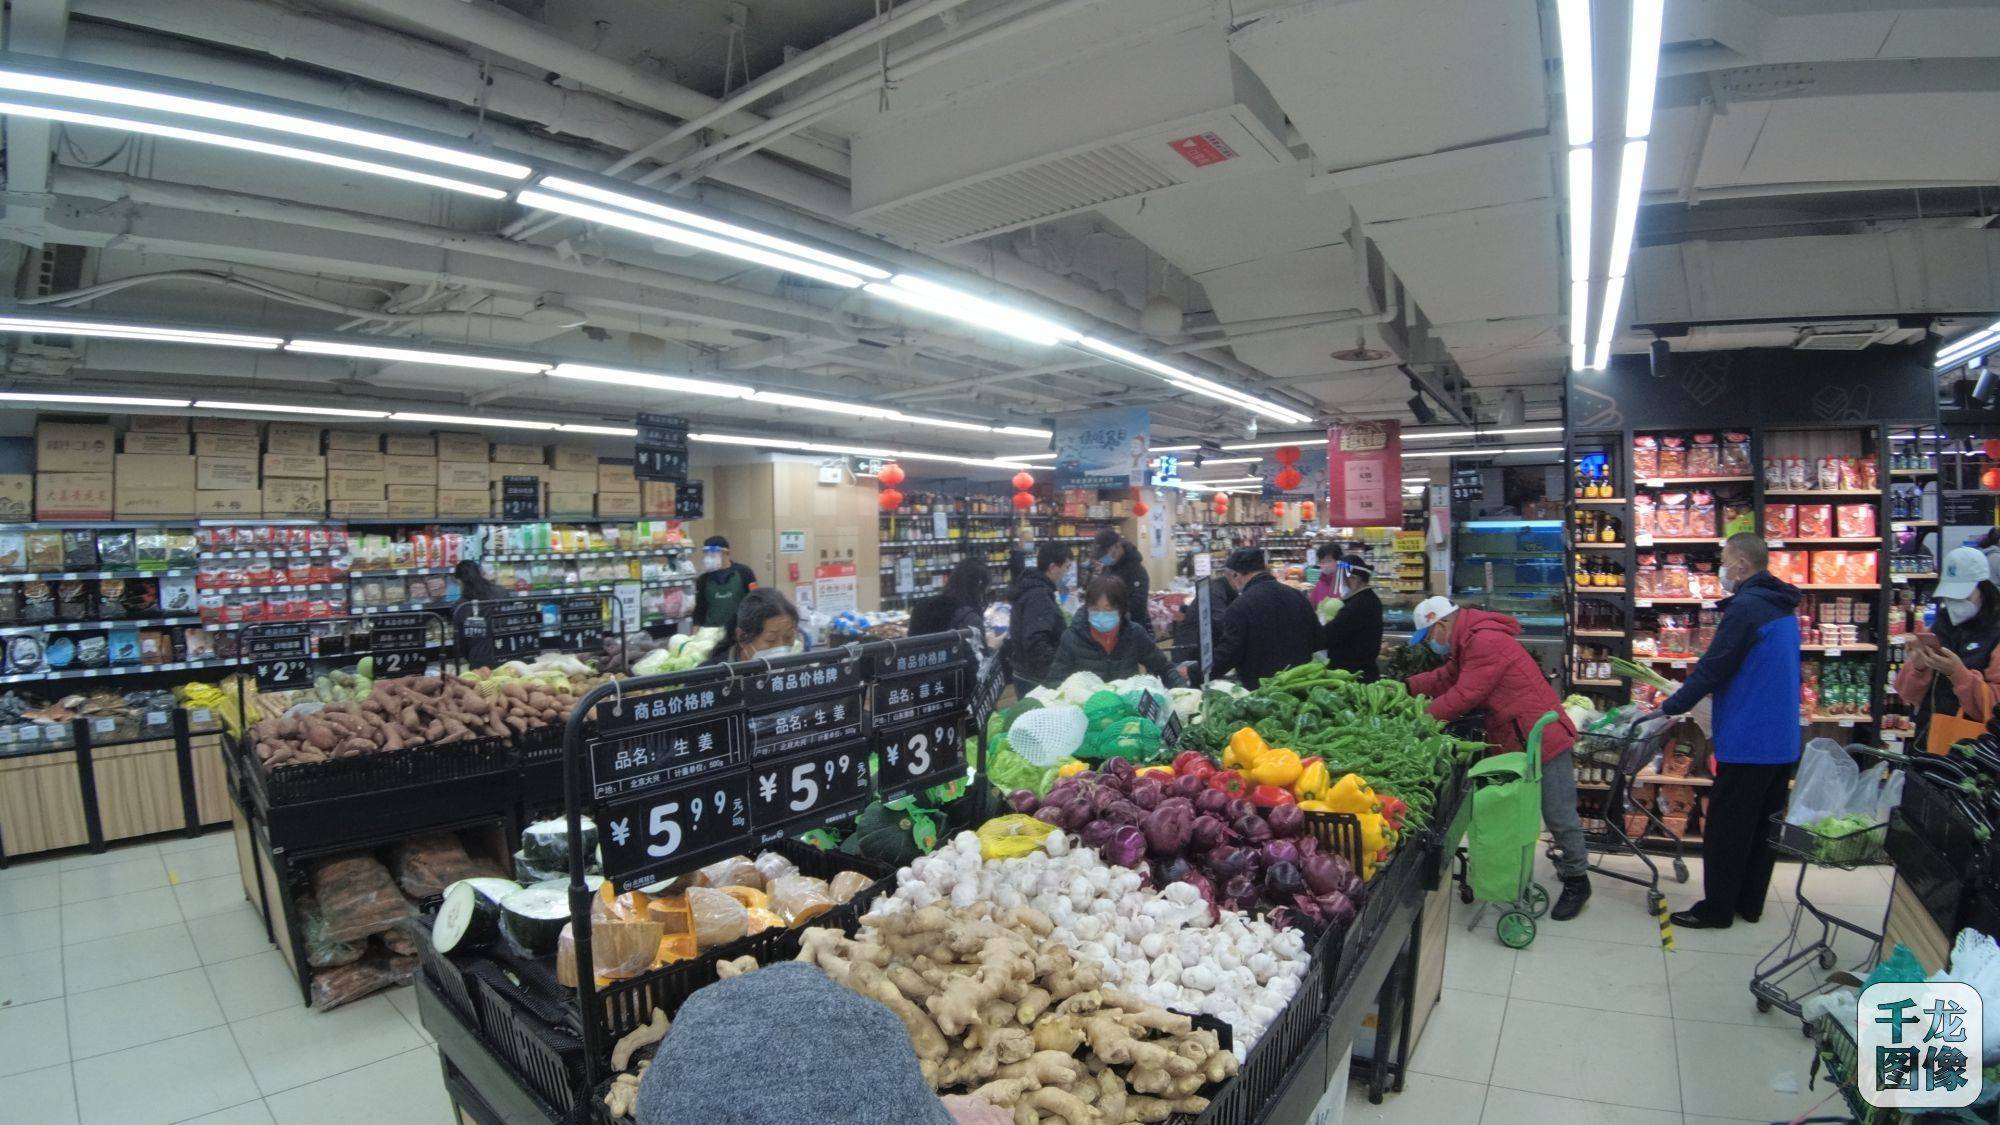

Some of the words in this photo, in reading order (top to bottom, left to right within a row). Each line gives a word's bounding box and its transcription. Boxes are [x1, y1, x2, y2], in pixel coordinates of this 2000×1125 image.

[897, 650, 948, 671] 商品价格牌
[771, 667, 838, 692] 商品价格牌
[634, 690, 715, 721] 商品价格牌
[814, 704, 846, 725] 生姜
[673, 732, 714, 757] 生姜
[630, 774, 661, 789] 北京大兴
